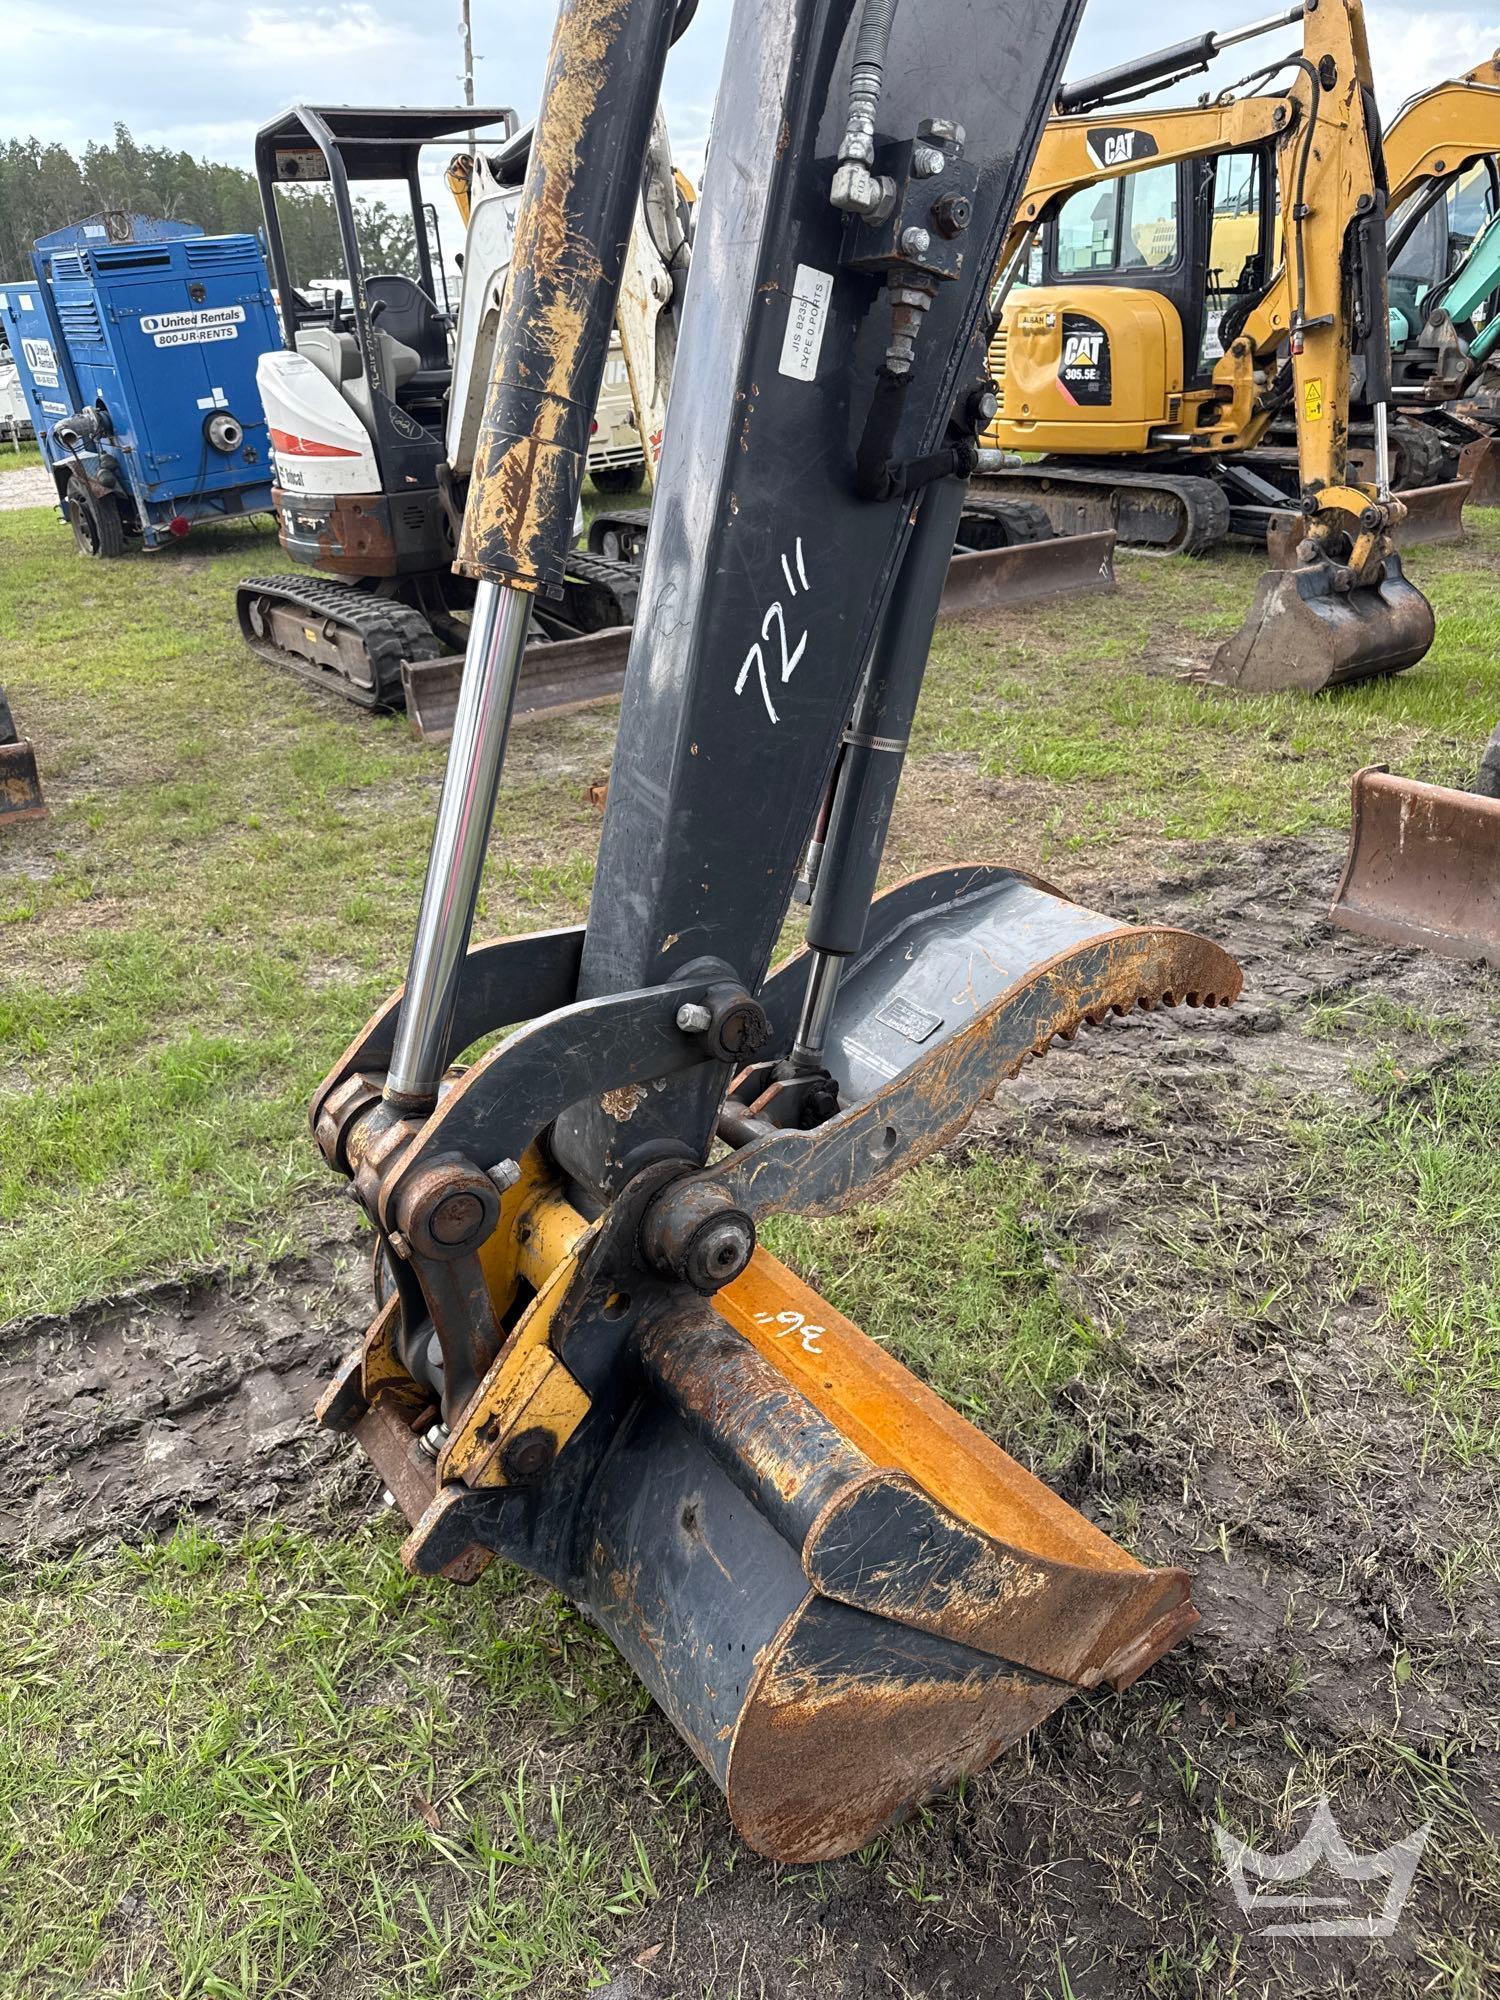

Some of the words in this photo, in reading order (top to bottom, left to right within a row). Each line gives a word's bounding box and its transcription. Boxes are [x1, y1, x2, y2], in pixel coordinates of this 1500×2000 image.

[1105, 131, 1135, 165] CAT
[161, 315, 197, 328] United
[200, 310, 240, 324] Rentals
[796, 295, 808, 330] B2351
[801, 338, 813, 368] TYPE
[809, 284, 823, 325] PORTS
[159, 327, 233, 345] 800-UR-RENTS
[792, 333, 801, 353] JIS
[1064, 337, 1104, 366] CAT
[734, 536, 811, 725] 72"
[752, 1310, 827, 1354] 36"
